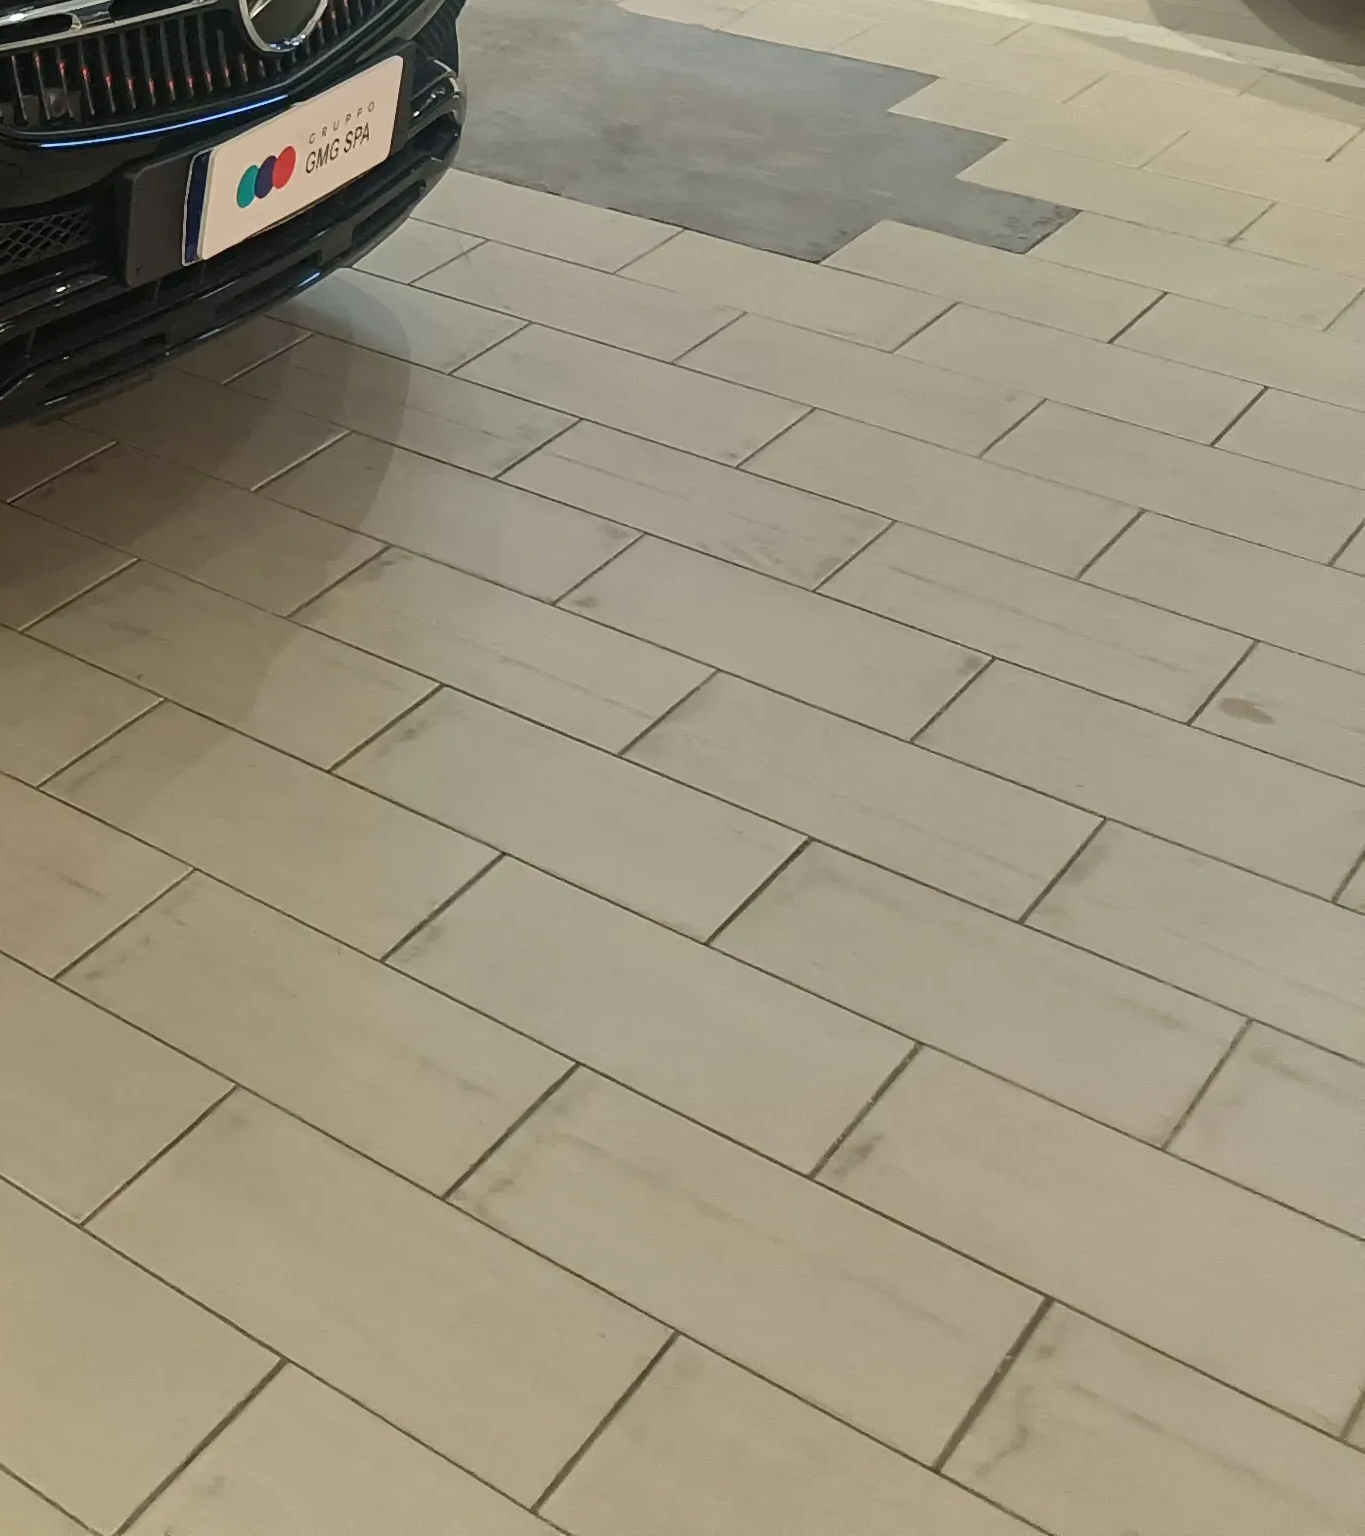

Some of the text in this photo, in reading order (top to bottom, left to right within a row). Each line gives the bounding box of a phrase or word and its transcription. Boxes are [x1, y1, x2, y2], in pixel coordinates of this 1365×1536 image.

[309, 101, 375, 144] GRUPPO
[305, 121, 370, 174] GMG SPA
